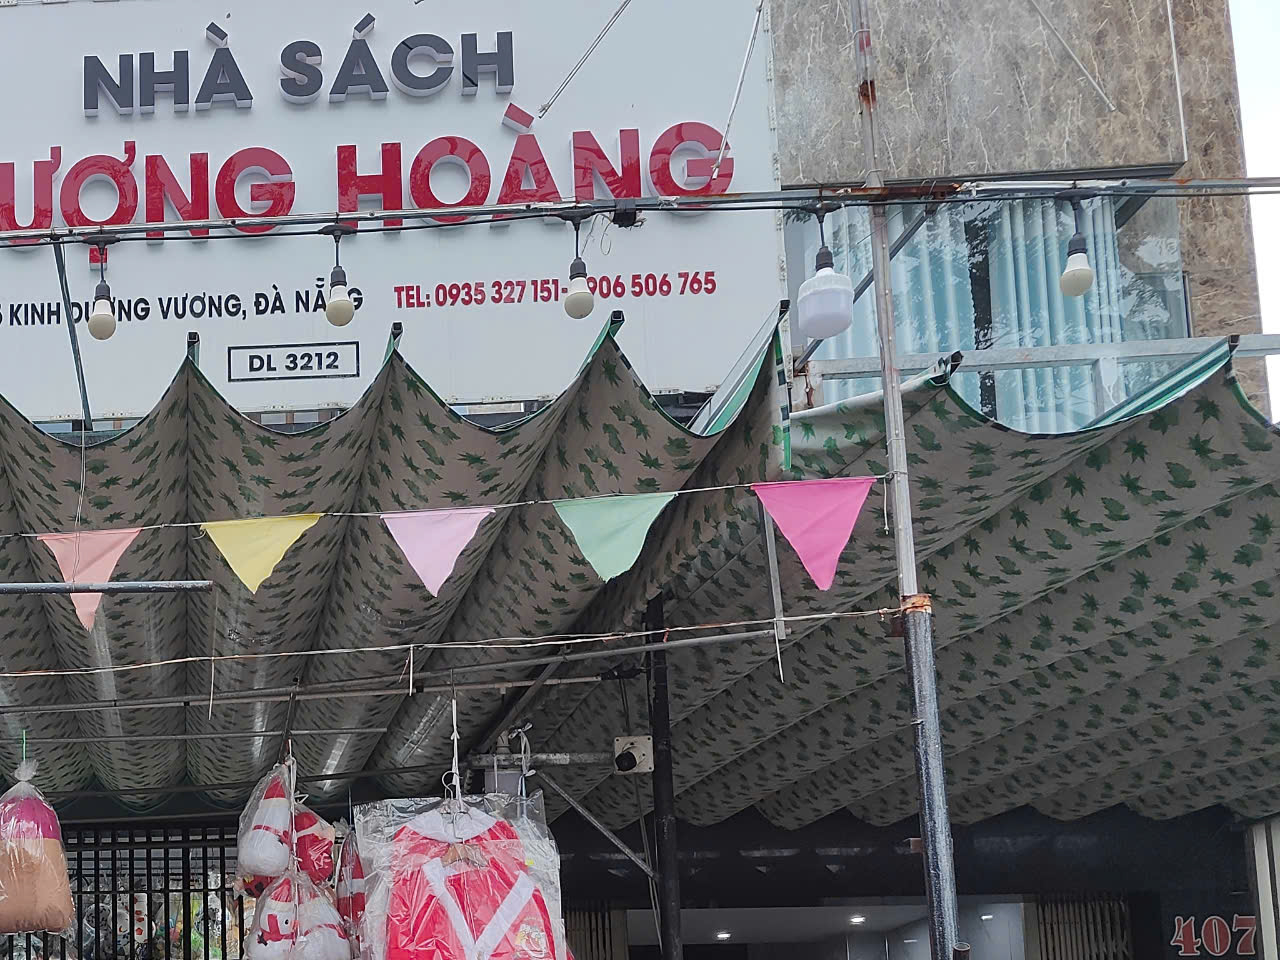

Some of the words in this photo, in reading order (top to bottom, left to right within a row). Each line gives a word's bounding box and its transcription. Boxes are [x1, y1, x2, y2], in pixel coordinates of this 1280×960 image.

[83, 22, 254, 116] NHÀ
[279, 13, 515, 104] SÁCH
[337, 103, 735, 232] HOÀNG
[9, 301, 61, 326] KINH
[158, 292, 248, 321] VƯƠNG,
[254, 284, 286, 316] ĐÀ
[295, 277, 364, 313] NẴG
[394, 285, 431, 308] TEL:
[434, 282, 486, 307] 0935
[490, 280, 527, 304] 327
[583, 275, 626, 300] 906
[630, 273, 672, 297] 506
[677, 271, 717, 295] 765
[248, 353, 277, 373] DL
[284, 351, 340, 372] 3212
[1170, 914, 1257, 956] 407
